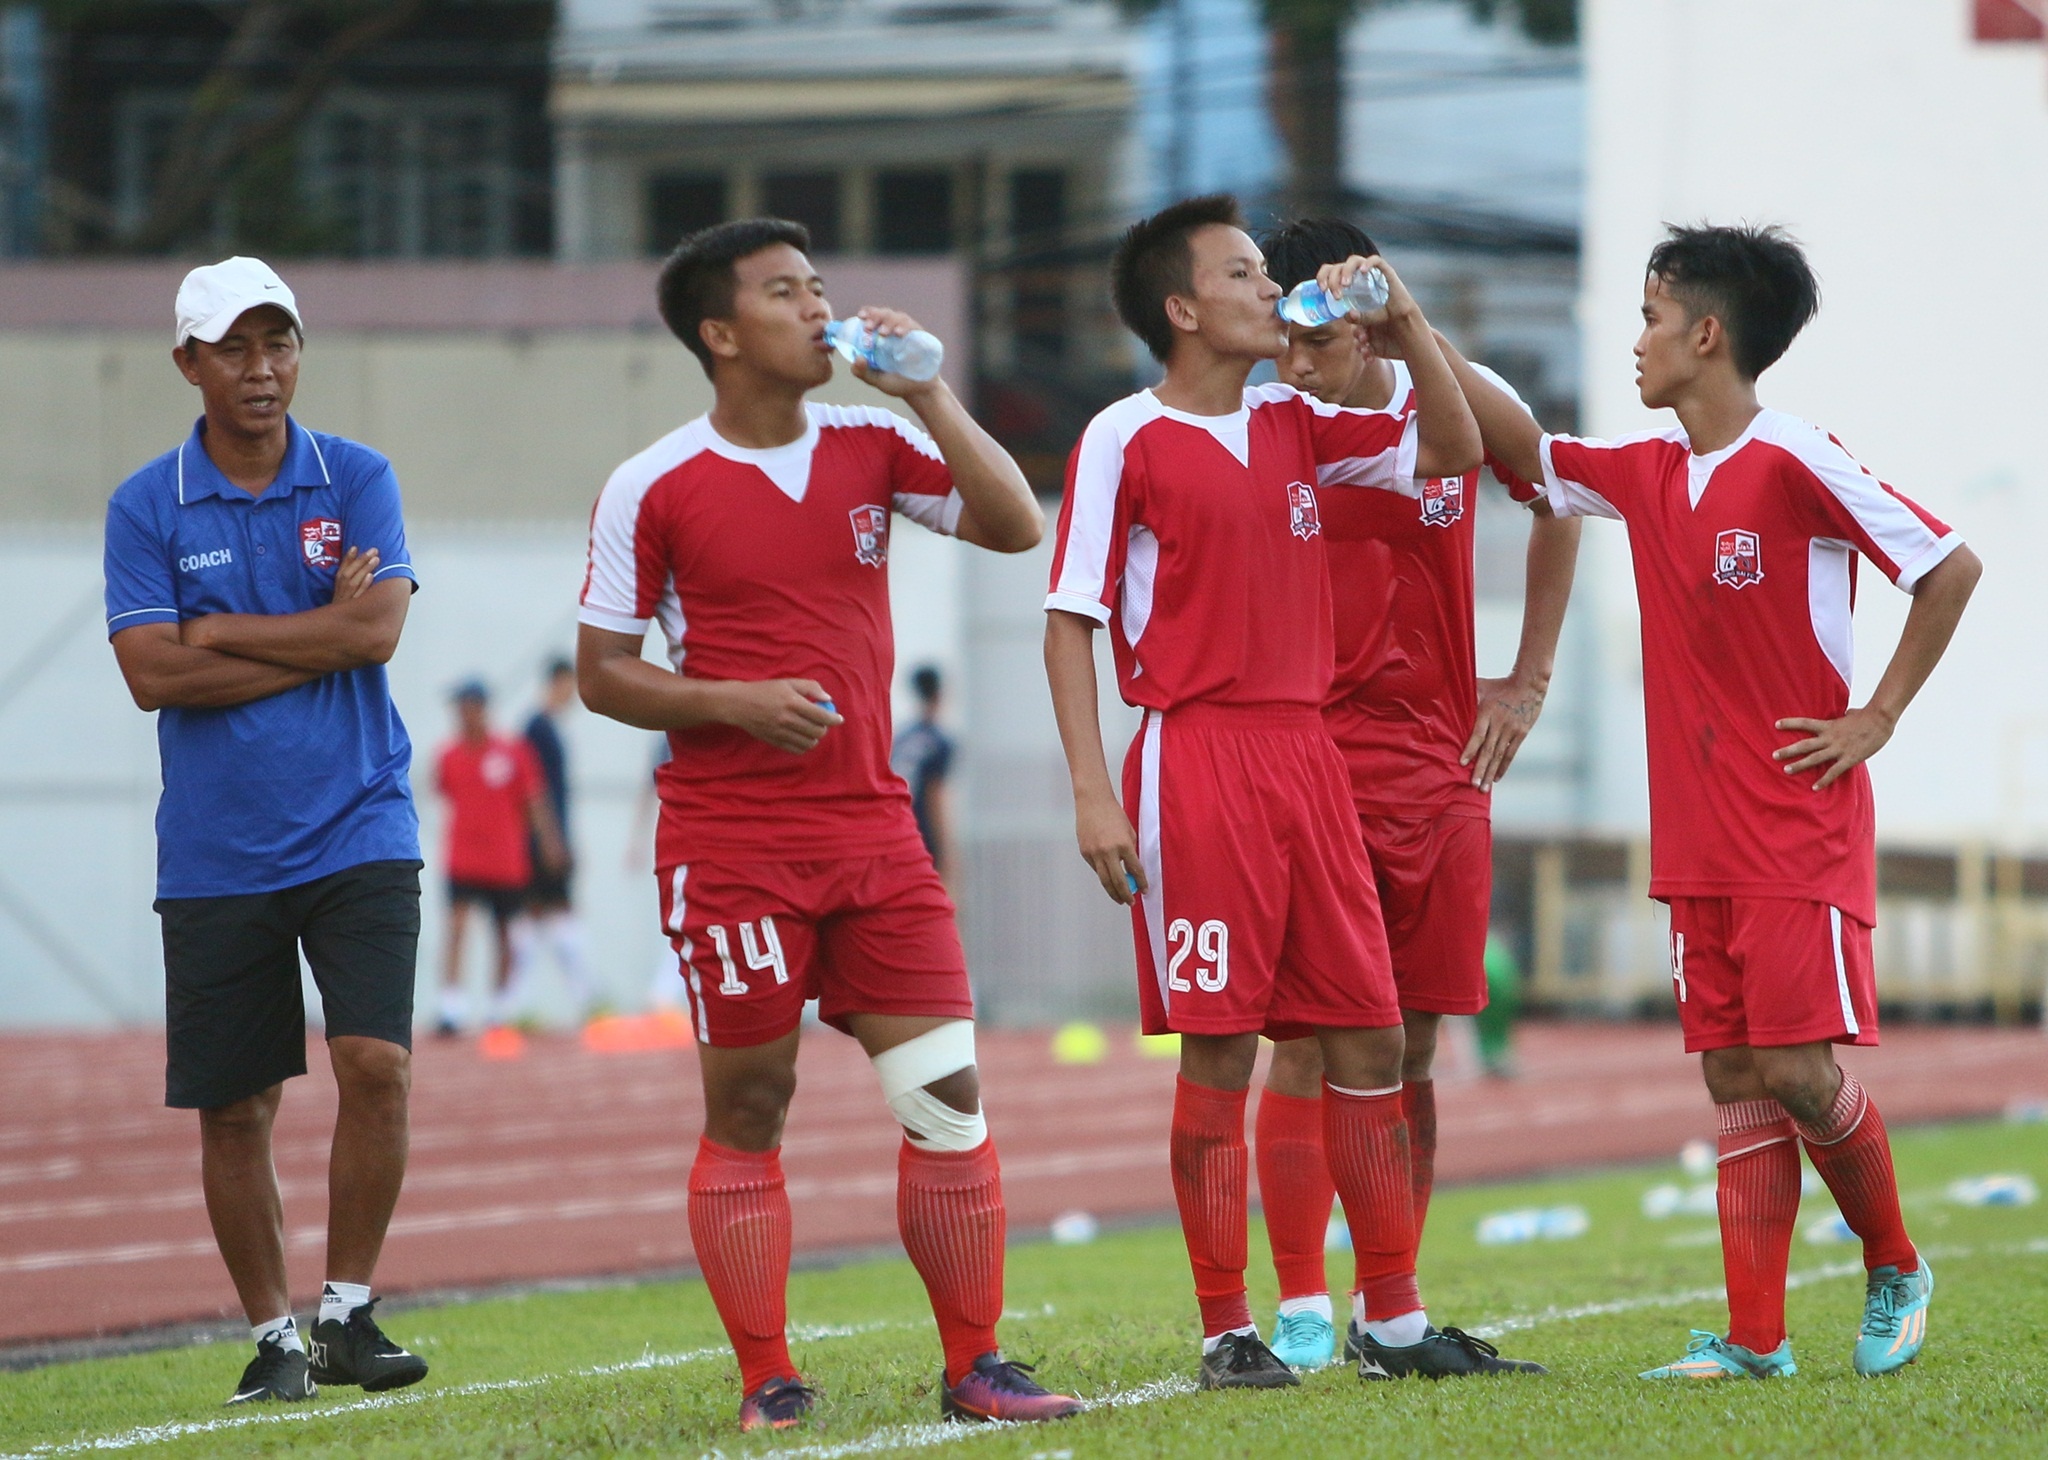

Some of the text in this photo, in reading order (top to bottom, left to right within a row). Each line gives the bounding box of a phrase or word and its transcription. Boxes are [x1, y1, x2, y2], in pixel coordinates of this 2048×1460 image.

[179, 548, 232, 572] COACH
[706, 915, 789, 995] 14
[1168, 918, 1229, 993] 29
